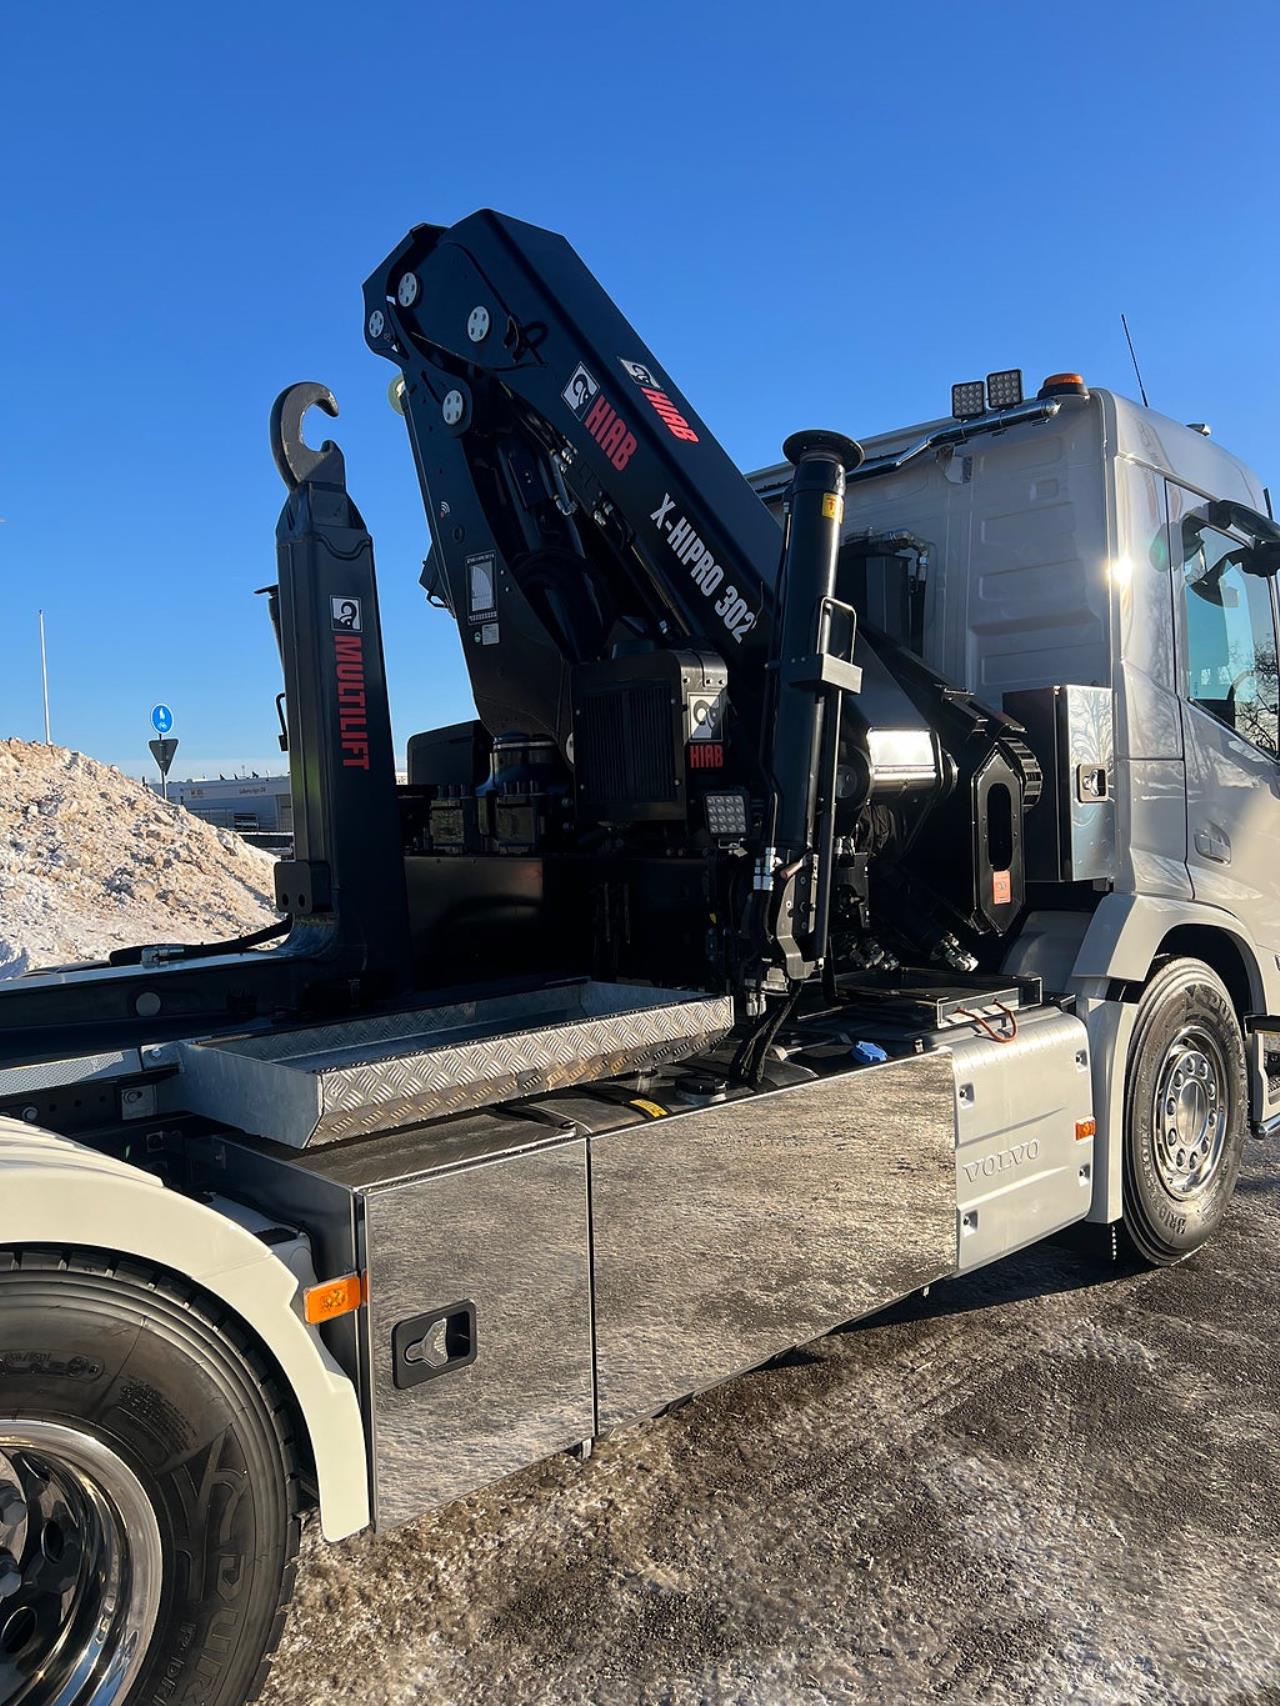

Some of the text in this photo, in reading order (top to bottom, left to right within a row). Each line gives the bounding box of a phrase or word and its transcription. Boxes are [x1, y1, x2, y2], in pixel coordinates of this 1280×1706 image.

[584, 395, 637, 470] HIAB
[640, 387, 699, 442] HIAB
[650, 492, 755, 644] X-HIPRO 302
[334, 635, 369, 769] MULTILIFT
[690, 745, 724, 768] HIAB
[962, 1136, 1041, 1184] VOLVO
